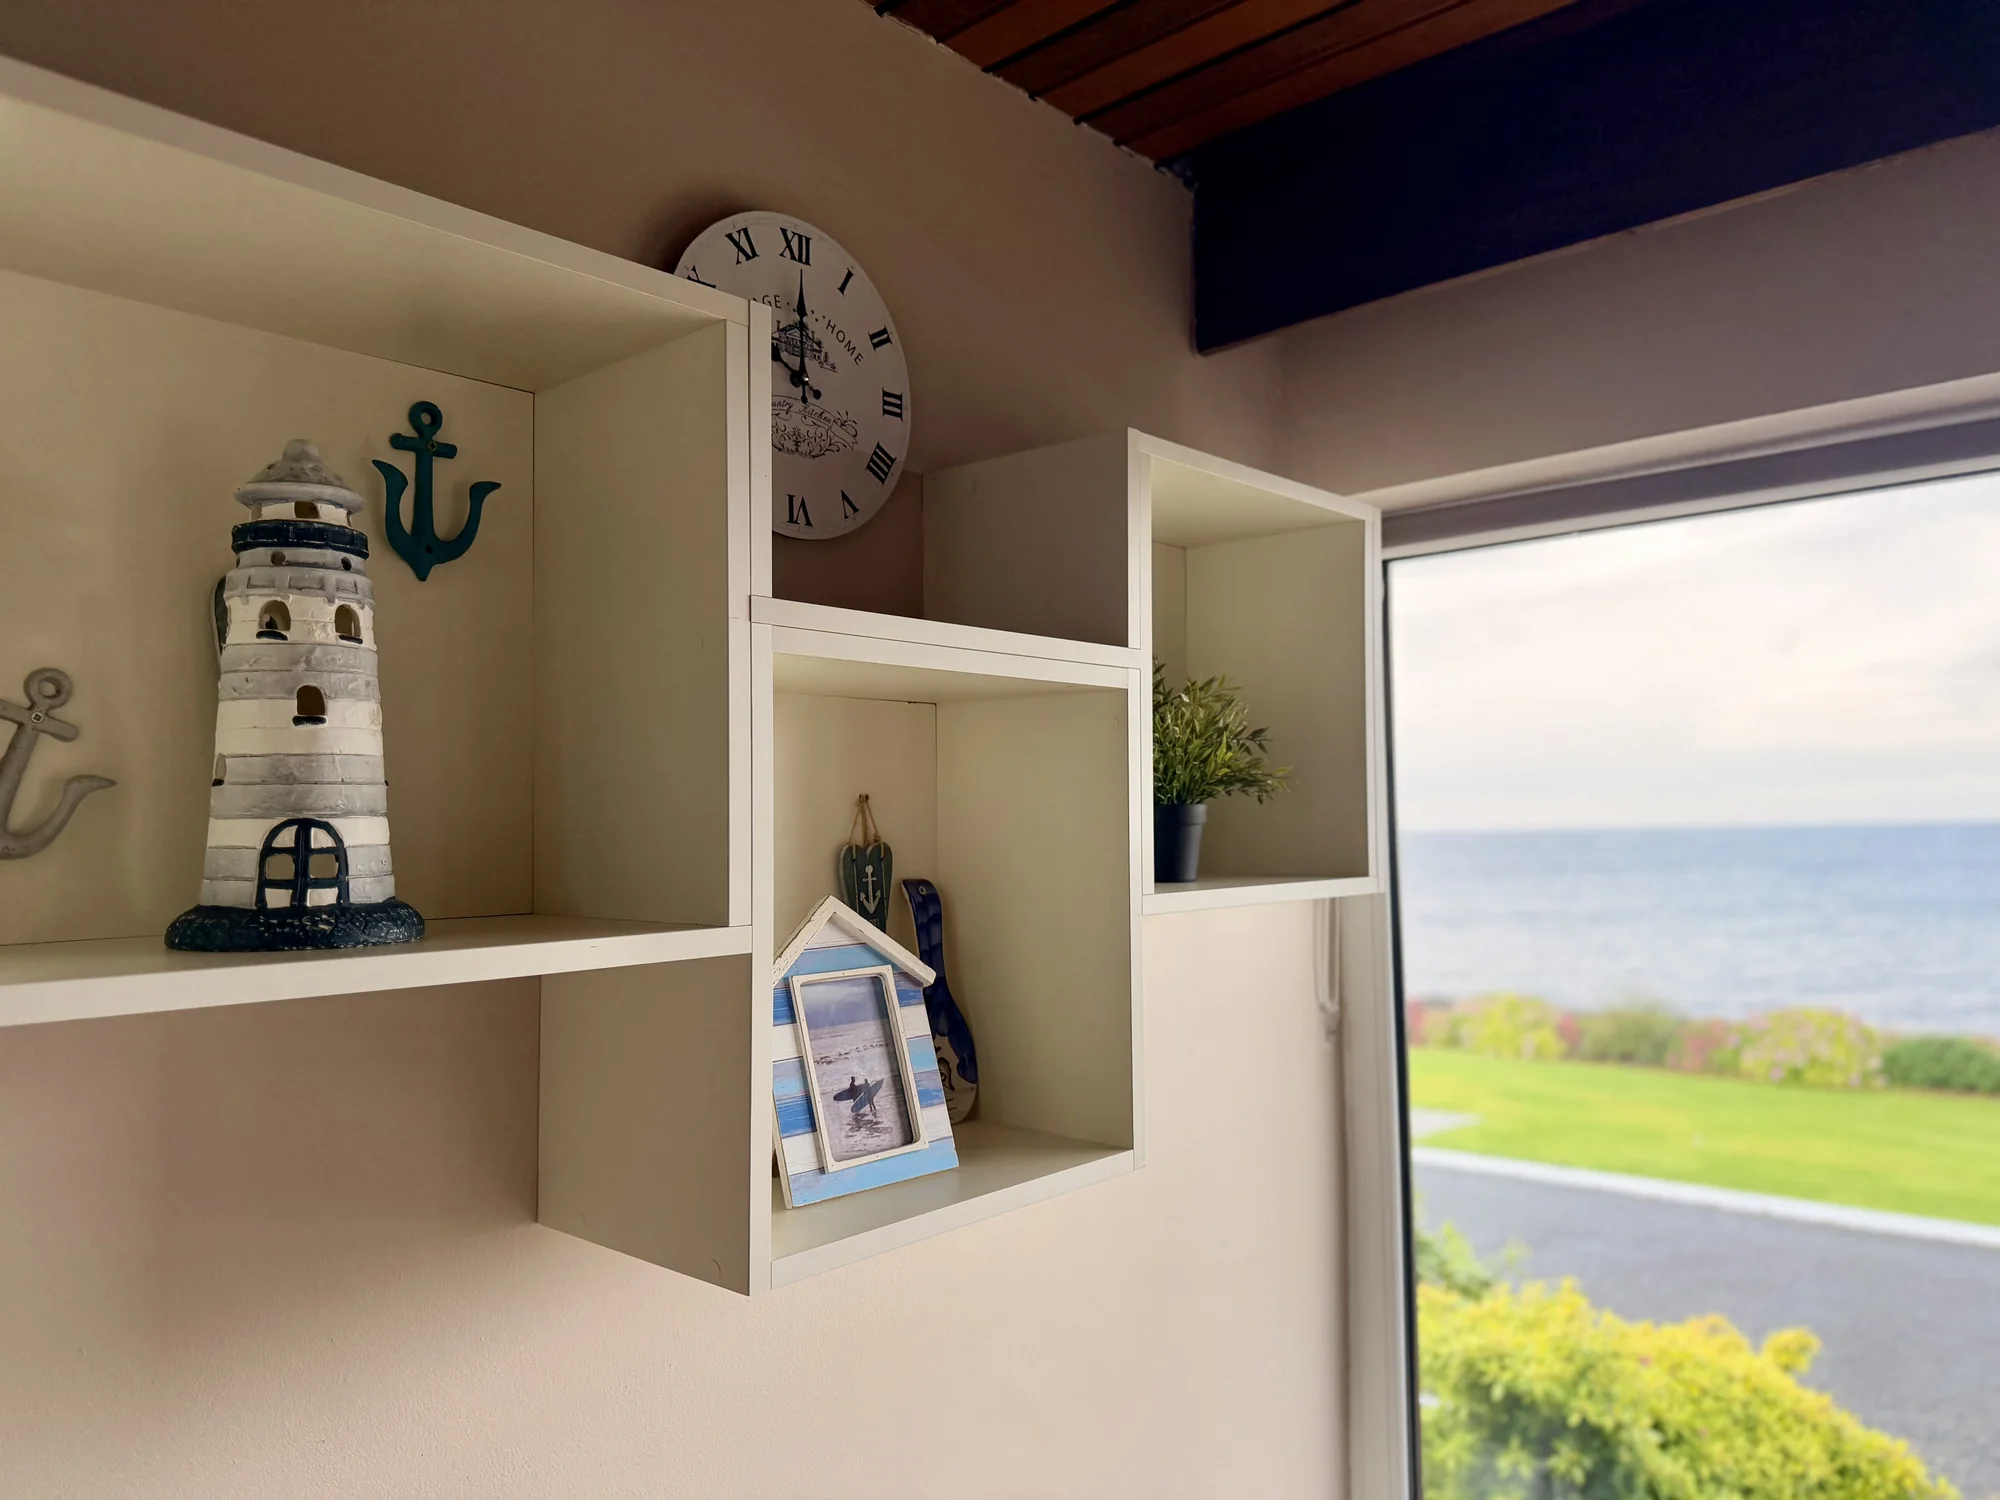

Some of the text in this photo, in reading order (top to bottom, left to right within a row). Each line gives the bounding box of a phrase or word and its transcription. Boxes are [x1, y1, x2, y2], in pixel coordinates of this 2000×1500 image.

[725, 226, 760, 265] XI
[779, 226, 812, 267] XII
[836, 267, 855, 297] I
[752, 294, 864, 366] GE HOME
[867, 324, 893, 352] II
[882, 387, 904, 422] III
[865, 441, 898, 487] IIII
[840, 489, 860, 520] V
